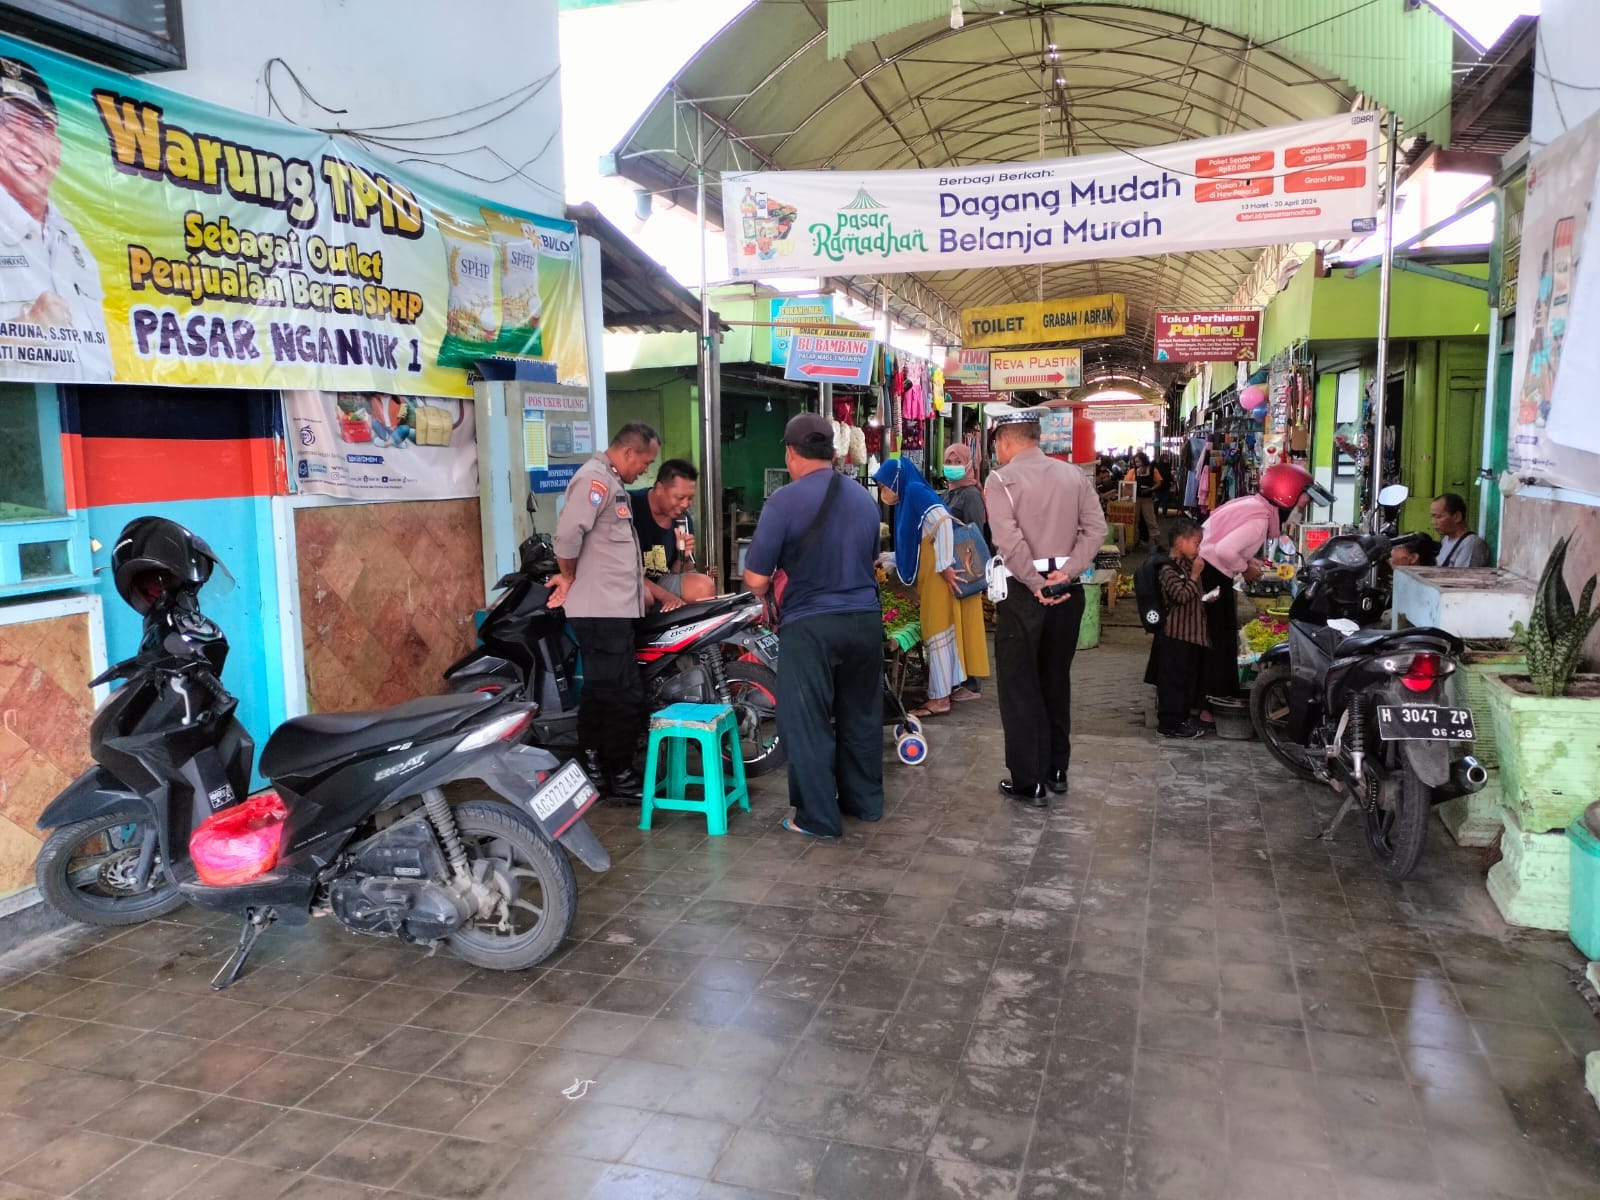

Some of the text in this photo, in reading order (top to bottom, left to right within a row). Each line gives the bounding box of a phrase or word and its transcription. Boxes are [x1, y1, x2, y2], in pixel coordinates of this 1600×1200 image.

[1229, 155, 1261, 163] Sembako
[1299, 145, 1335, 155] Cashback
[92, 88, 424, 240] Warung TPID
[939, 168, 1055, 186] Berbagi Berkah:
[1304, 174, 1345, 184] Grand Prize
[939, 172, 1181, 220] Dagang Mudah
[1284, 199, 1299, 207] April
[808, 222, 928, 262] Ramadhan
[939, 211, 1162, 254] Belanja Murah
[184, 210, 383, 284] Sebagai Outlet
[541, 234, 574, 253] BULO
[461, 258, 490, 279] SPHP
[511, 251, 535, 271] SPHP
[128, 244, 424, 325] Penjualan Beras SPHP
[972, 316, 1024, 336] TOILET
[1043, 311, 1077, 329] GRABAH
[1084, 308, 1114, 325] ABRAK
[1160, 313, 1255, 324] Toko Perhiasan
[1169, 323, 1245, 338] Pahlevy
[133, 309, 423, 373] PASAR NGANJUK 1
[797, 338, 868, 354] BU BAMBANG
[17, 347, 75, 363] NGANJUK
[528, 396, 585, 410] POS UKUR ULANG
[1381, 708, 1468, 725] H 3047 ZP
